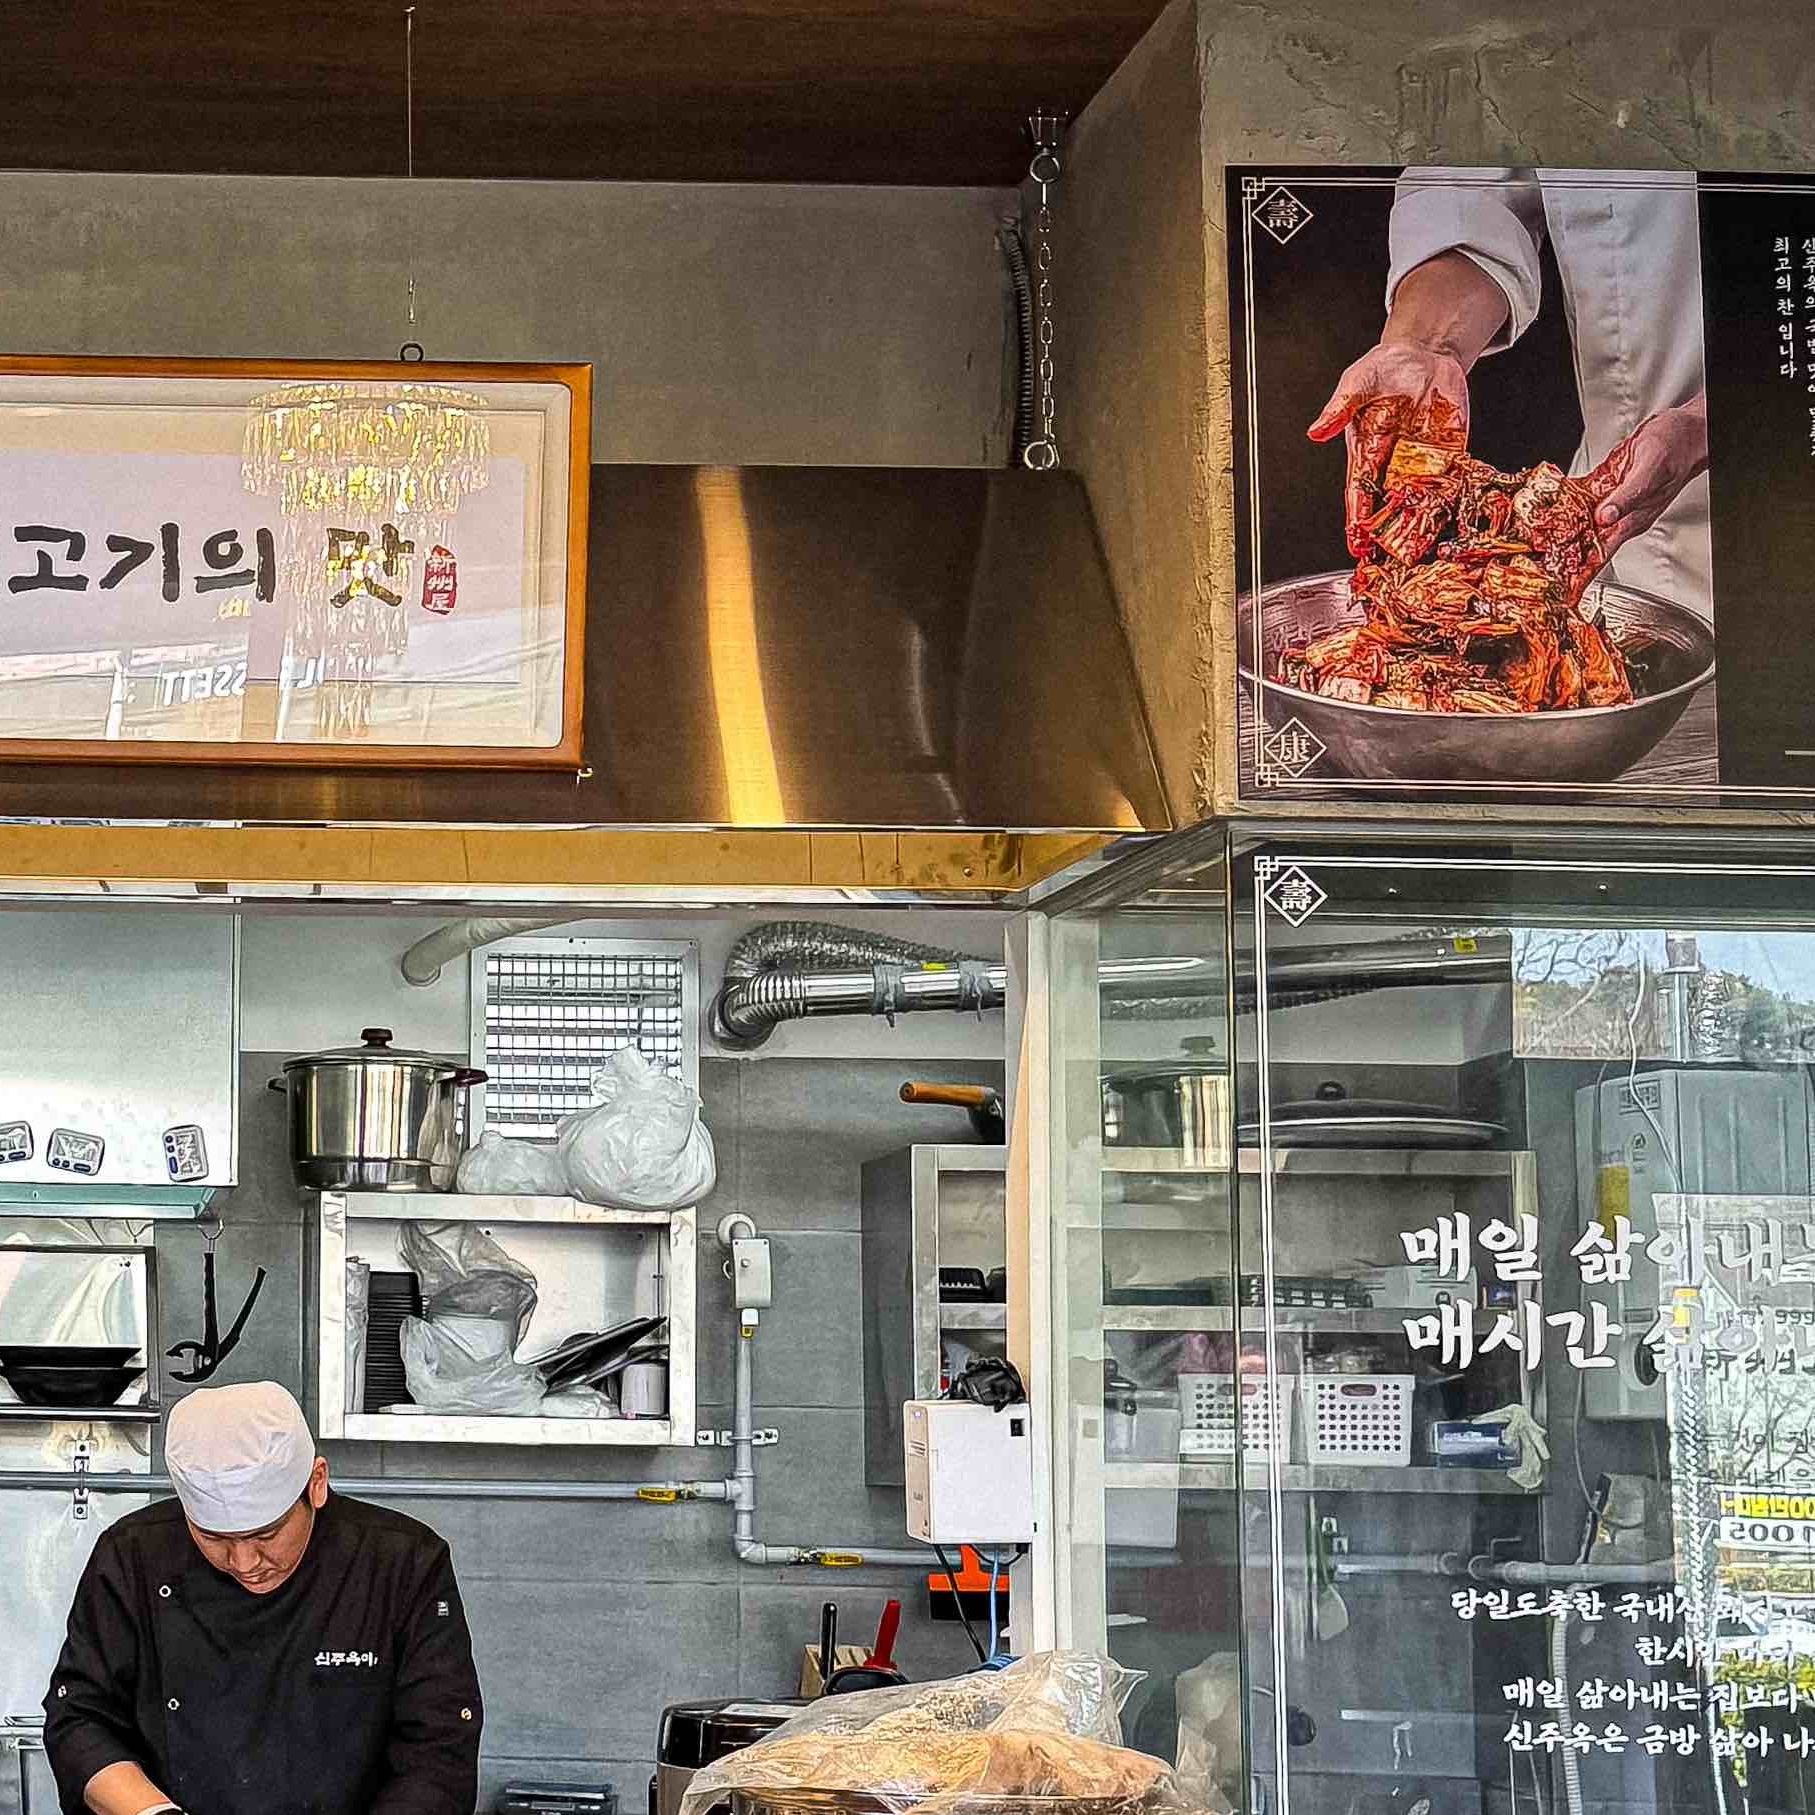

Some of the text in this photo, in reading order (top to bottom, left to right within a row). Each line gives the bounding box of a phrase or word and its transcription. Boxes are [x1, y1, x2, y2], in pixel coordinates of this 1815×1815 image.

[1399, 1210, 1545, 1283] 매일
[1401, 1297, 1623, 1370] 매시간
[1450, 1588, 1607, 1622] 당일도축한
[1502, 1676, 1569, 1710] 매일
[1575, 1677, 1703, 1712] 삶아내는
[1503, 1720, 1630, 1754] 신주옥은
[1636, 1724, 1701, 1756] 금방
[1708, 1726, 1775, 1759] 삶아
